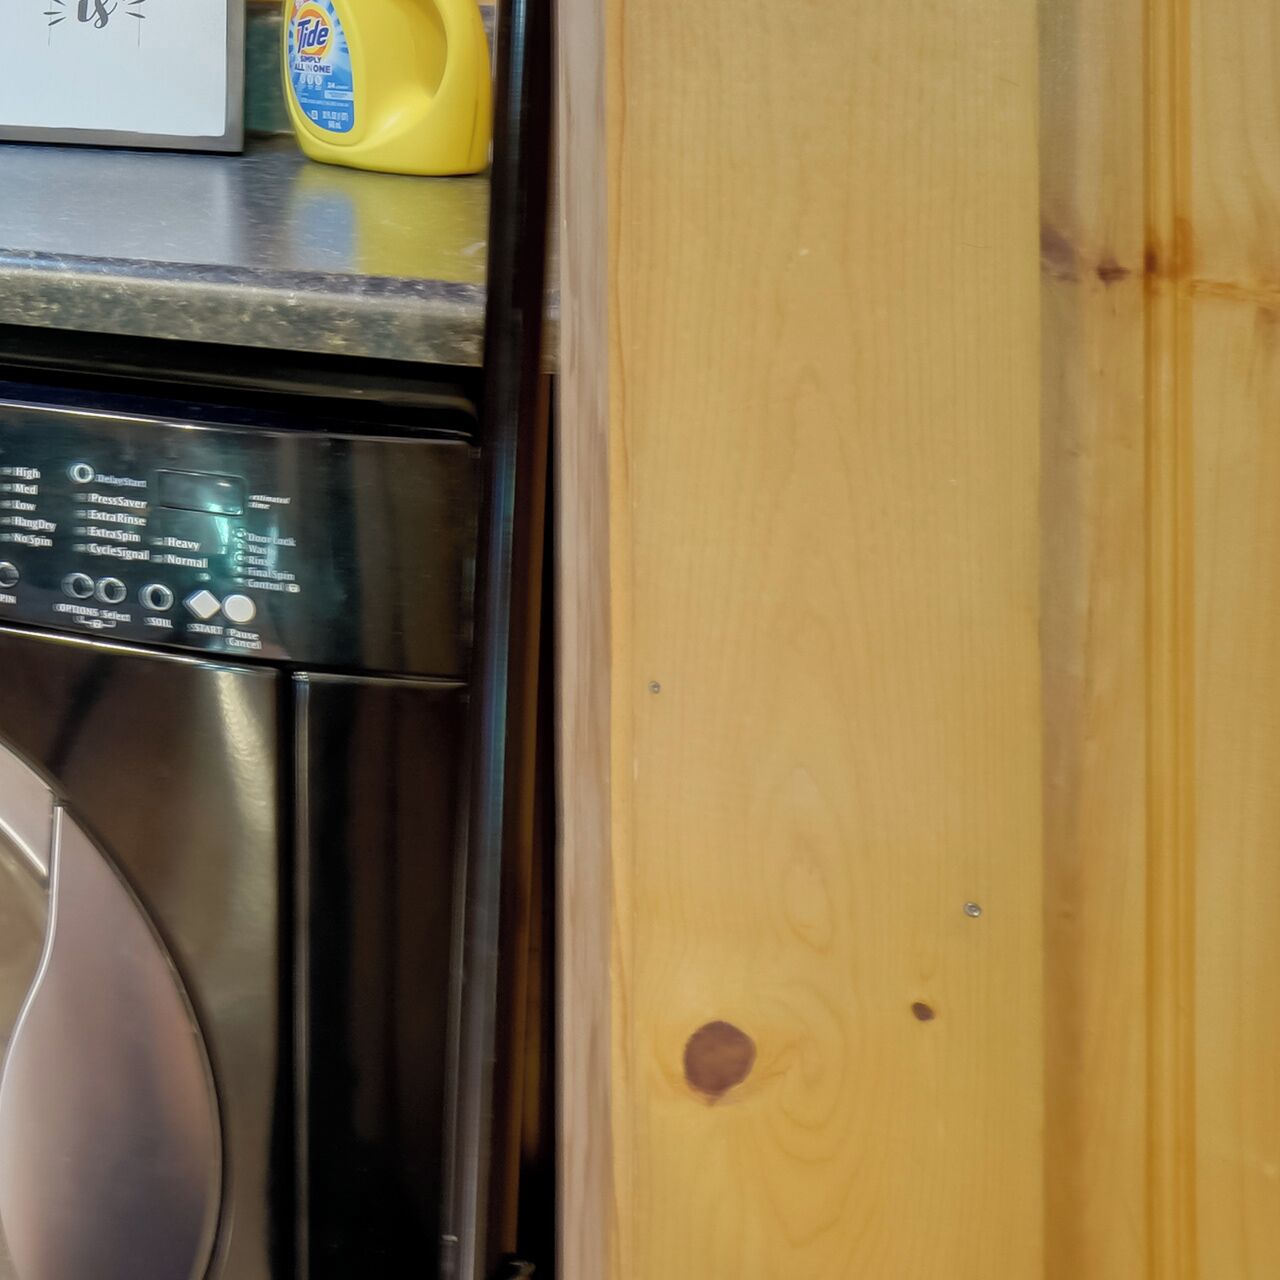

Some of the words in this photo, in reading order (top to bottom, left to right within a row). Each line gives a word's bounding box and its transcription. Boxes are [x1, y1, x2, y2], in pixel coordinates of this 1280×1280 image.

[298, 19, 330, 55] Tide
[300, 56, 322, 64] SIMPLY
[313, 65, 331, 74] ONE
[15, 467, 40, 480] High
[14, 483, 38, 495] Med
[14, 500, 37, 511] Low
[166, 536, 202, 552] Heavy
[166, 554, 208, 568] Normal
